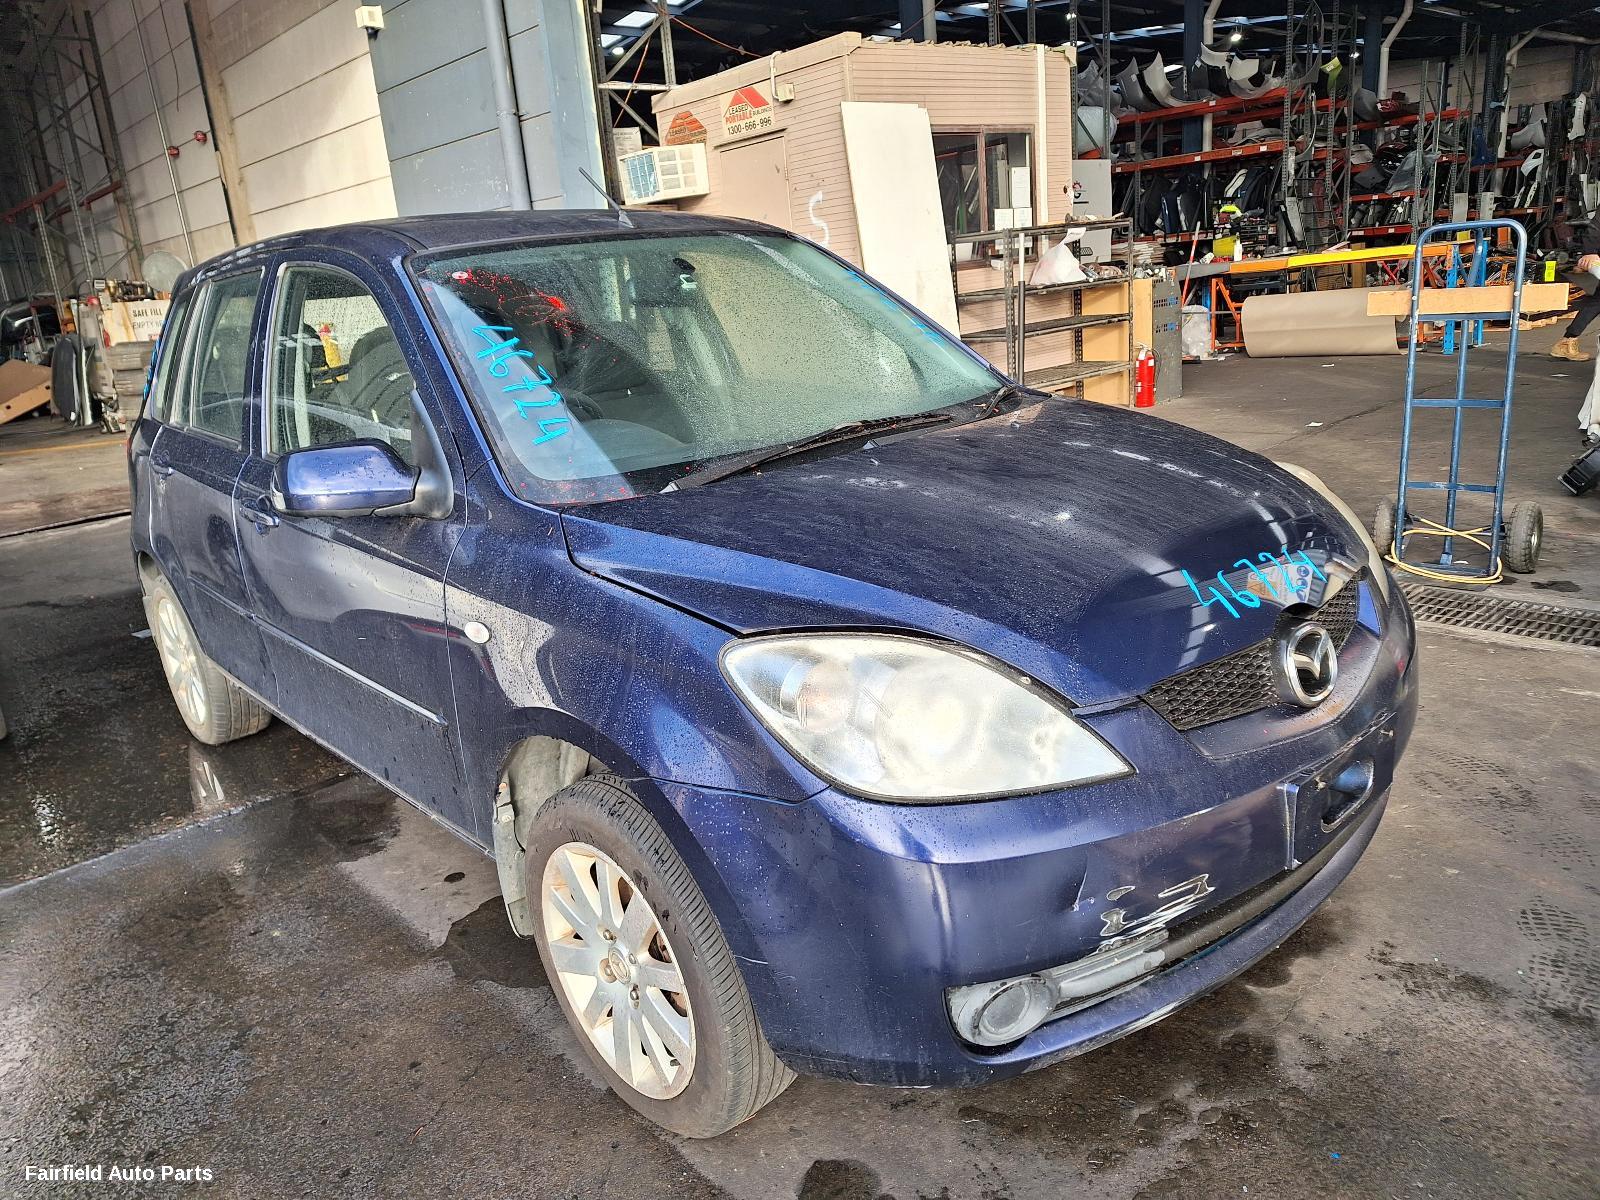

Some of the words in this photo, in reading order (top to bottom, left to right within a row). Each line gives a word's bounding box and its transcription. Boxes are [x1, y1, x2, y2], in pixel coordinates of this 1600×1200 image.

[725, 109, 752, 124] PORTABLE
[729, 103, 748, 115] LEASED
[727, 116, 772, 135] 1300-666-996
[132, 309, 149, 318] SAFE
[150, 308, 163, 316] FILL
[472, 325, 569, 446] 46724
[1181, 547, 1328, 619] 46724
